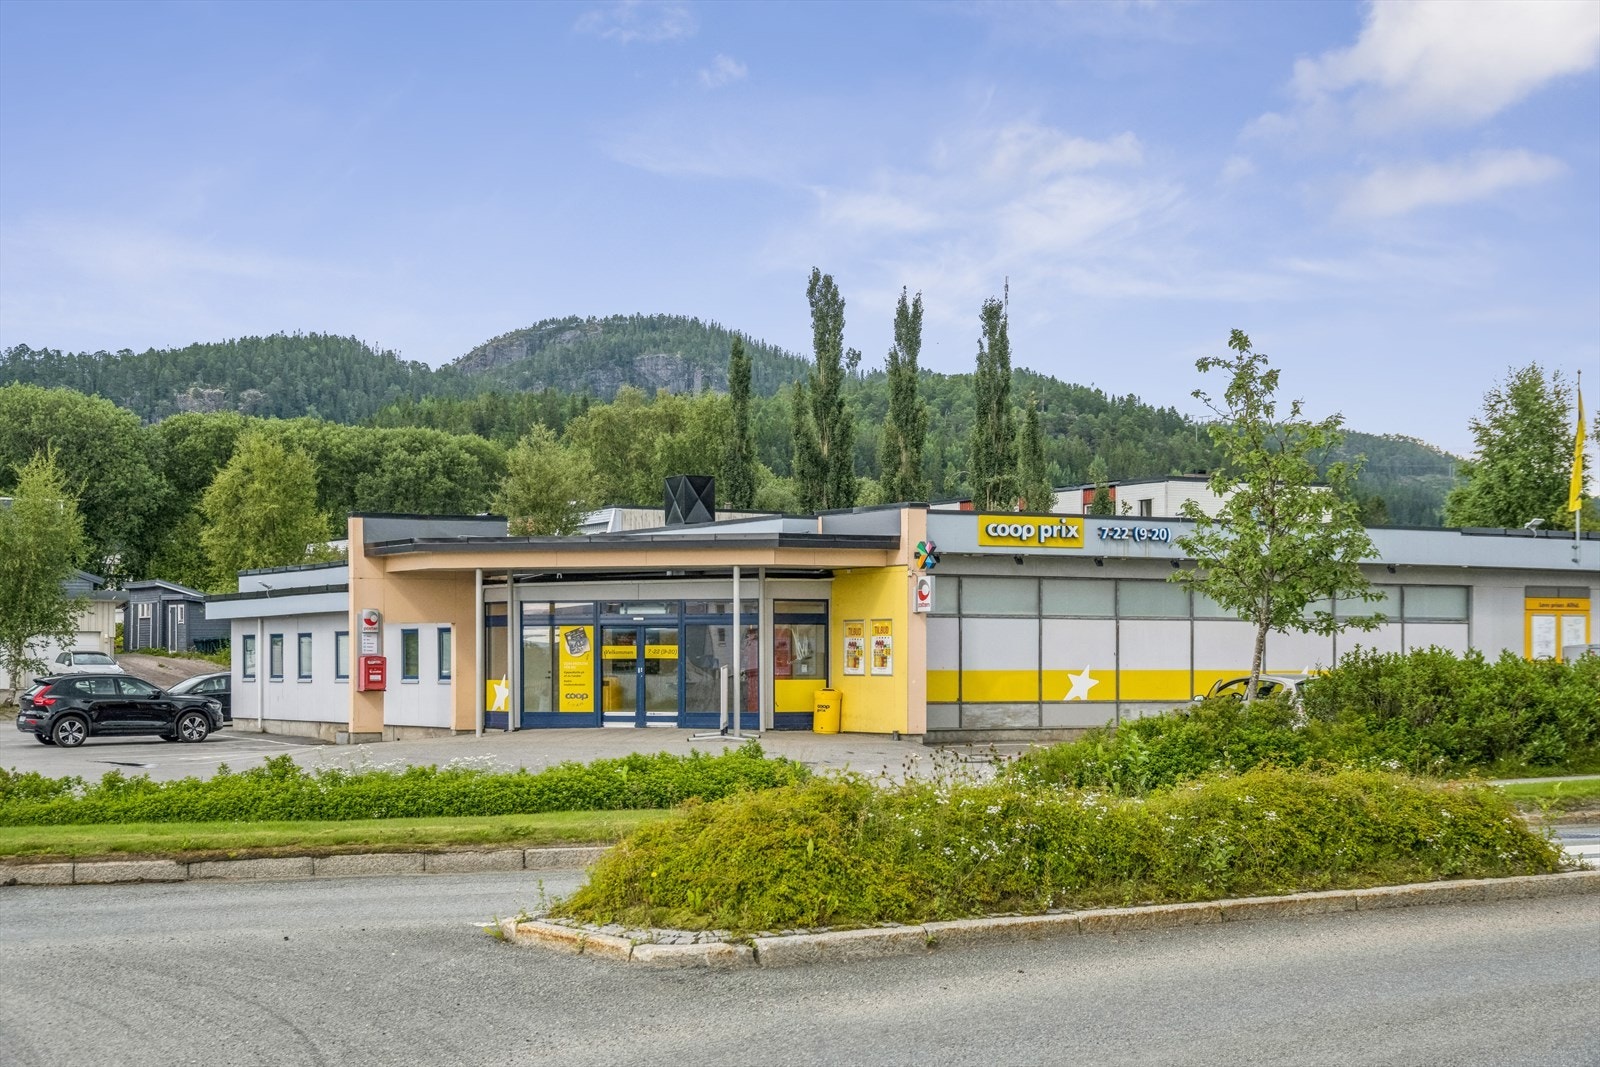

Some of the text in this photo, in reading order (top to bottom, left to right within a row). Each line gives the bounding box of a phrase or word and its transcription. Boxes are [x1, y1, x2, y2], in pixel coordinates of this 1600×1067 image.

[986, 518, 1080, 543] coop prix
[1099, 527, 1172, 543] 7-22 (9-20)
[565, 692, 589, 700] coop
